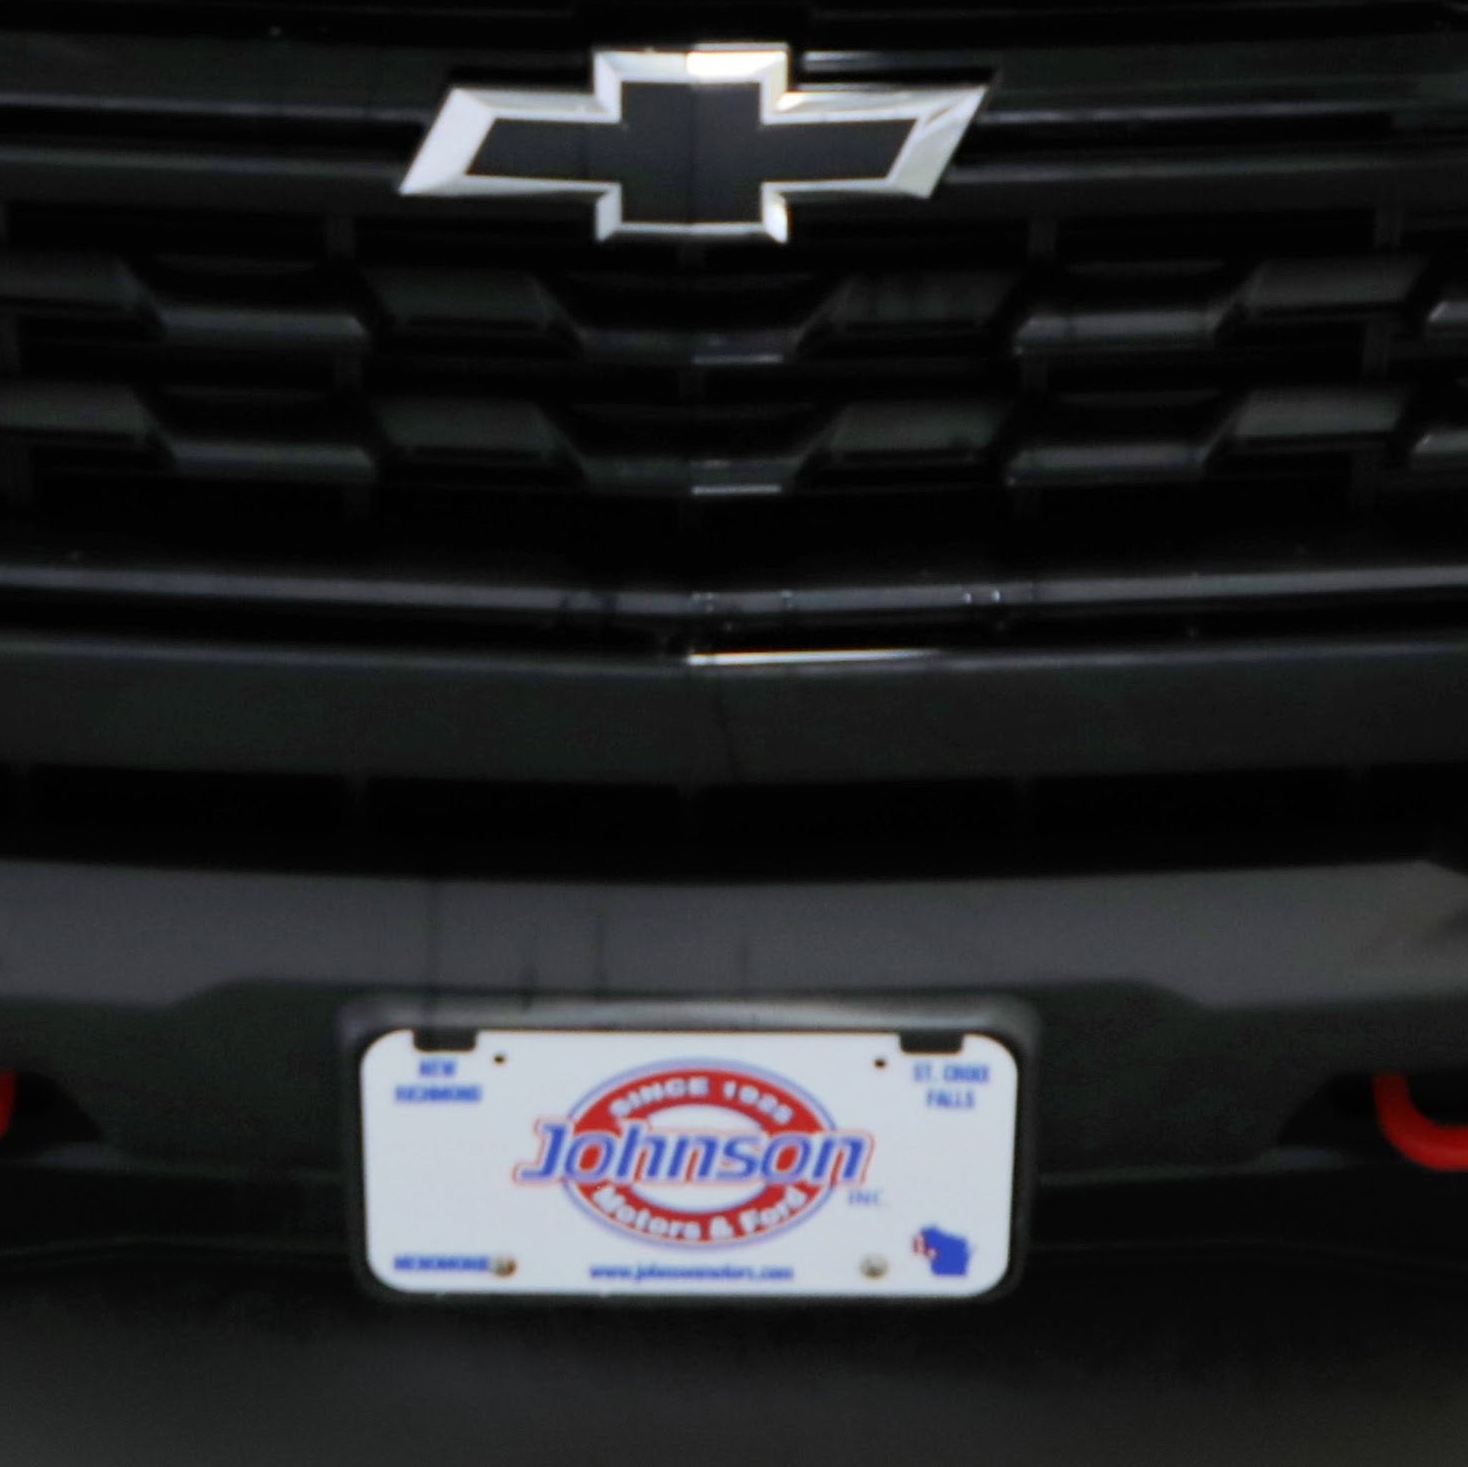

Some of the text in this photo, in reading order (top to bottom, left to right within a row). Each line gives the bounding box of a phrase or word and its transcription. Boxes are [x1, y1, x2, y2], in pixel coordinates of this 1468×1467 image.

[609, 1077, 709, 1118] SINCE
[926, 1090, 975, 1109] FALLS
[514, 1119, 871, 1186] Johnson
[592, 1185, 808, 1240] Motors & Ford
